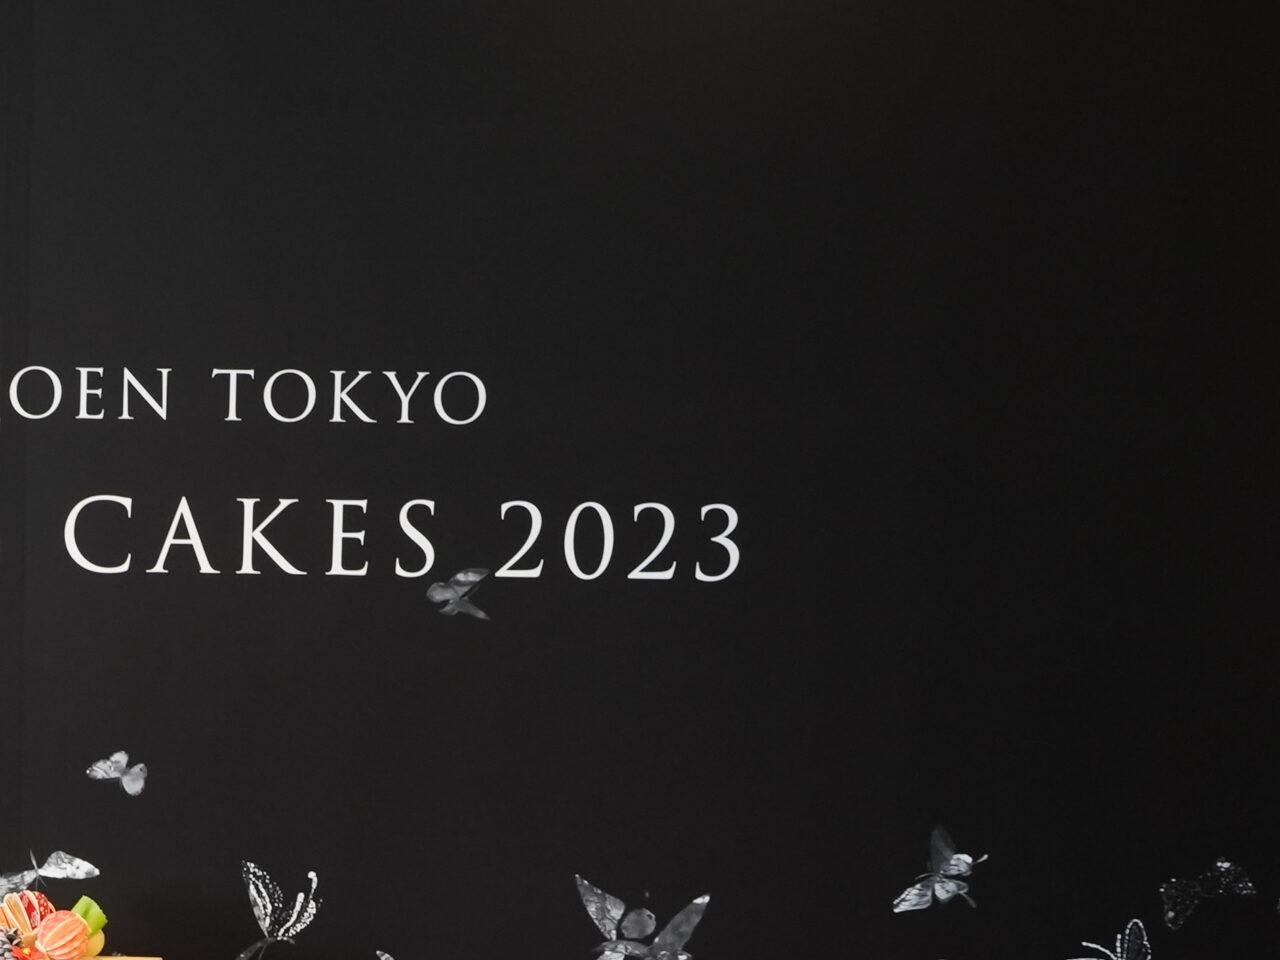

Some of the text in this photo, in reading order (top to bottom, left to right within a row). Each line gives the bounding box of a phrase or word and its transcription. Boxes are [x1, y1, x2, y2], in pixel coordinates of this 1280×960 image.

[211, 368, 488, 426] TOKYO
[63, 494, 436, 579] CAKES
[494, 500, 741, 582] 2023
